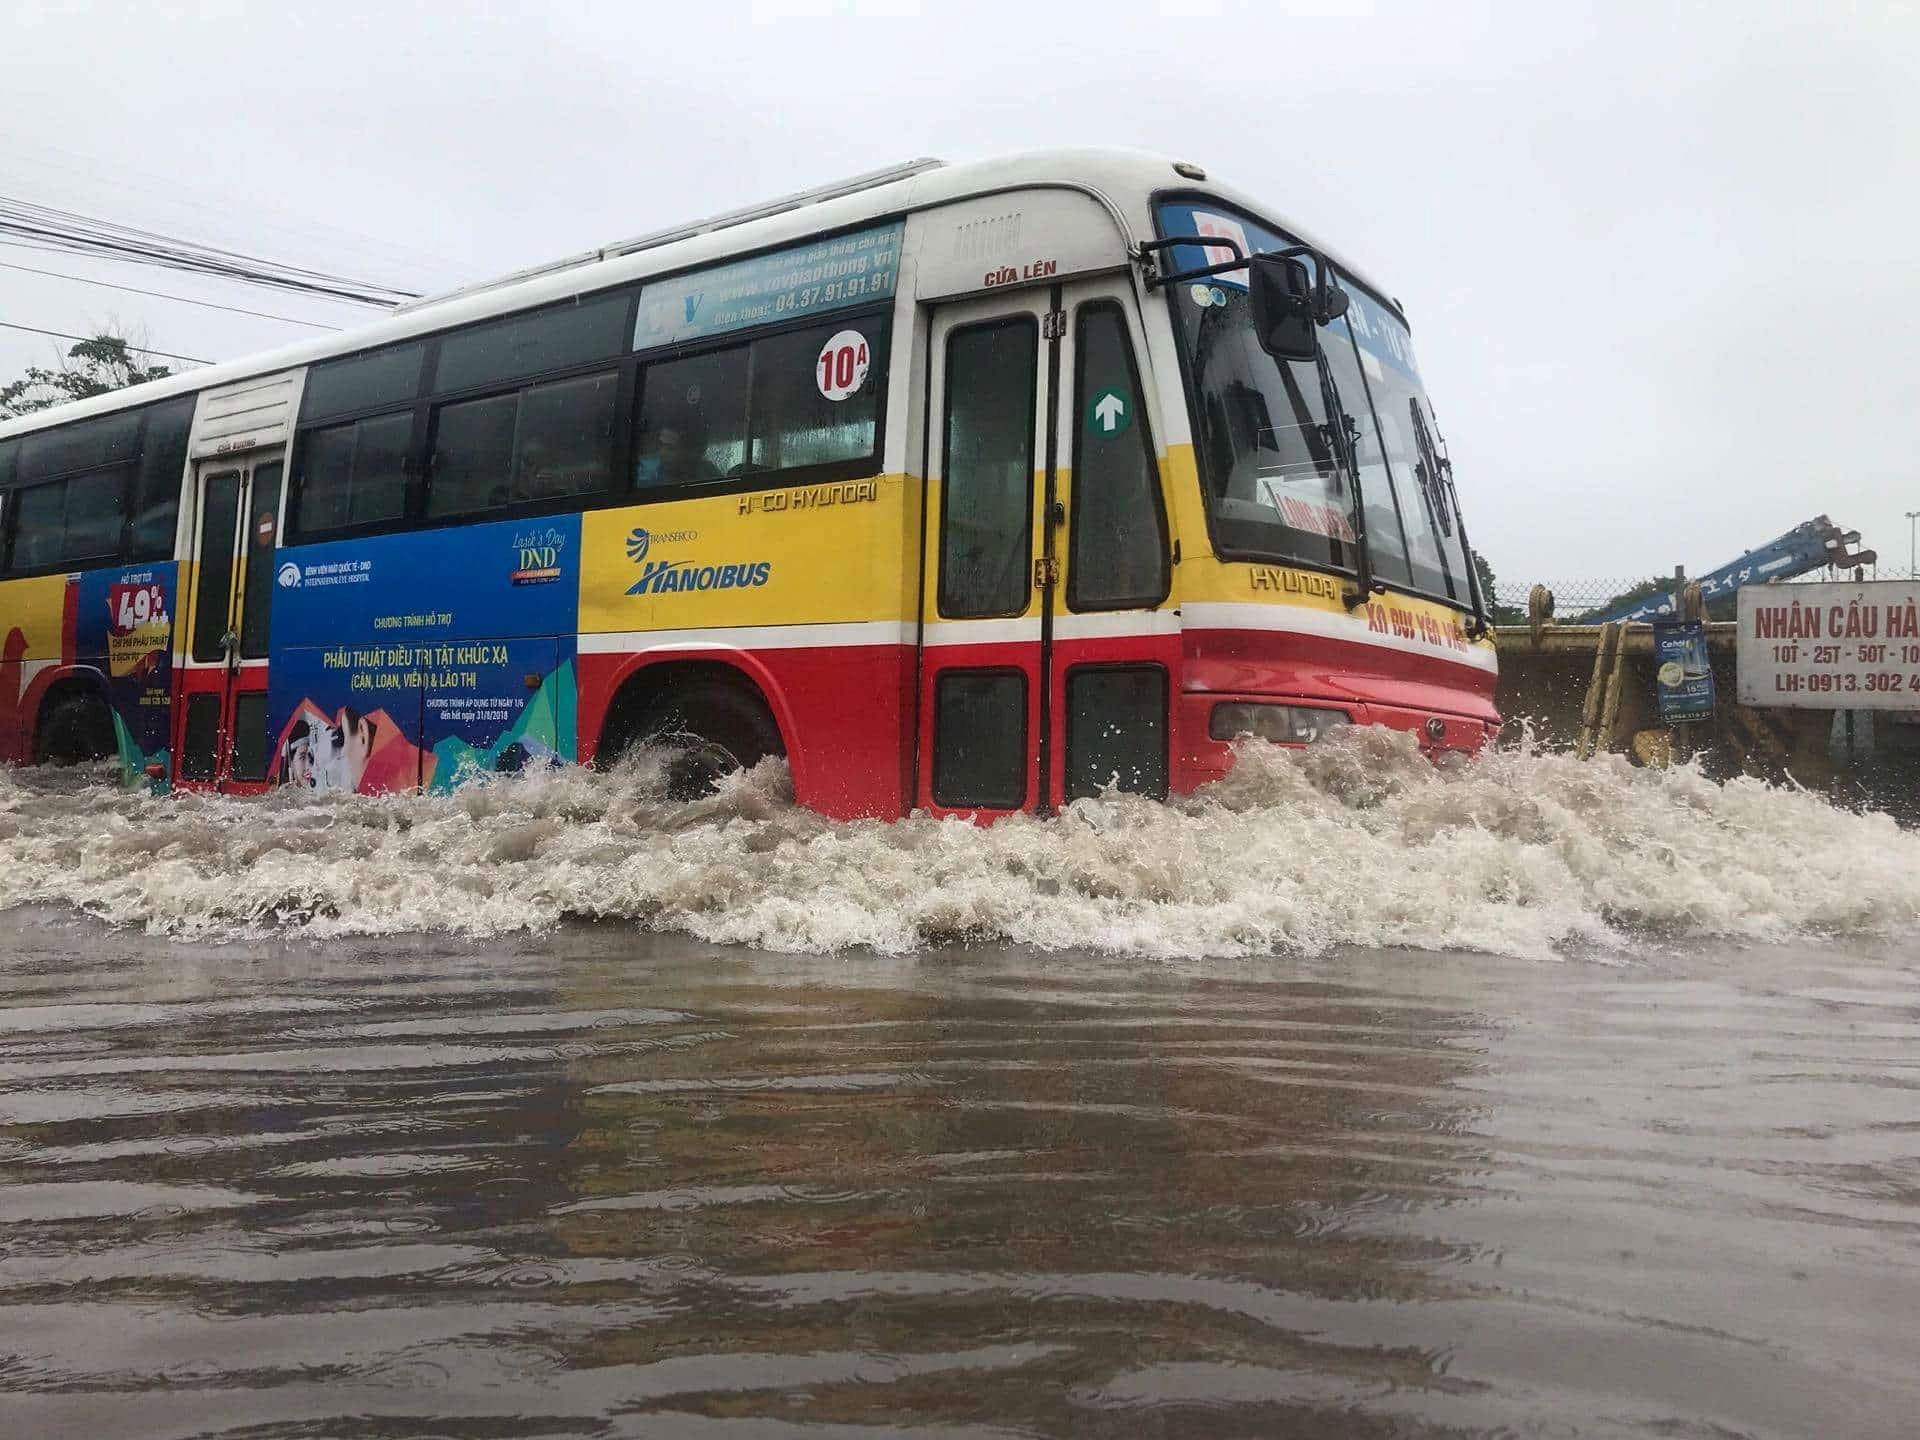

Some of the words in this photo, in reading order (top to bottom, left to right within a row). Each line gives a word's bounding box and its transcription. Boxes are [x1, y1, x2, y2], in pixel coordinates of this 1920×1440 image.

[984, 265, 1018, 287] CỬA
[1023, 259, 1057, 280] LÊN
[792, 482, 877, 510] HYUNDAI
[648, 530, 698, 544] TRANSERCO
[520, 547, 556, 570] DND
[625, 560, 771, 595] HANOIBUS
[323, 645, 351, 669] PHẪU
[352, 646, 386, 671] THUẬT
[388, 644, 412, 667] ĐIỀU
[414, 648, 433, 670] TRỊ
[434, 643, 455, 670] TẬT
[457, 642, 489, 665] KHÚC
[492, 645, 508, 668] XẠ
[1813, 645, 1841, 664] 25T
[1857, 644, 1887, 664] 50T
[376, 673, 401, 692] LOẠN,
[430, 673, 437, 688] &
[440, 669, 458, 688] LÃO
[460, 672, 477, 690] THỊ
